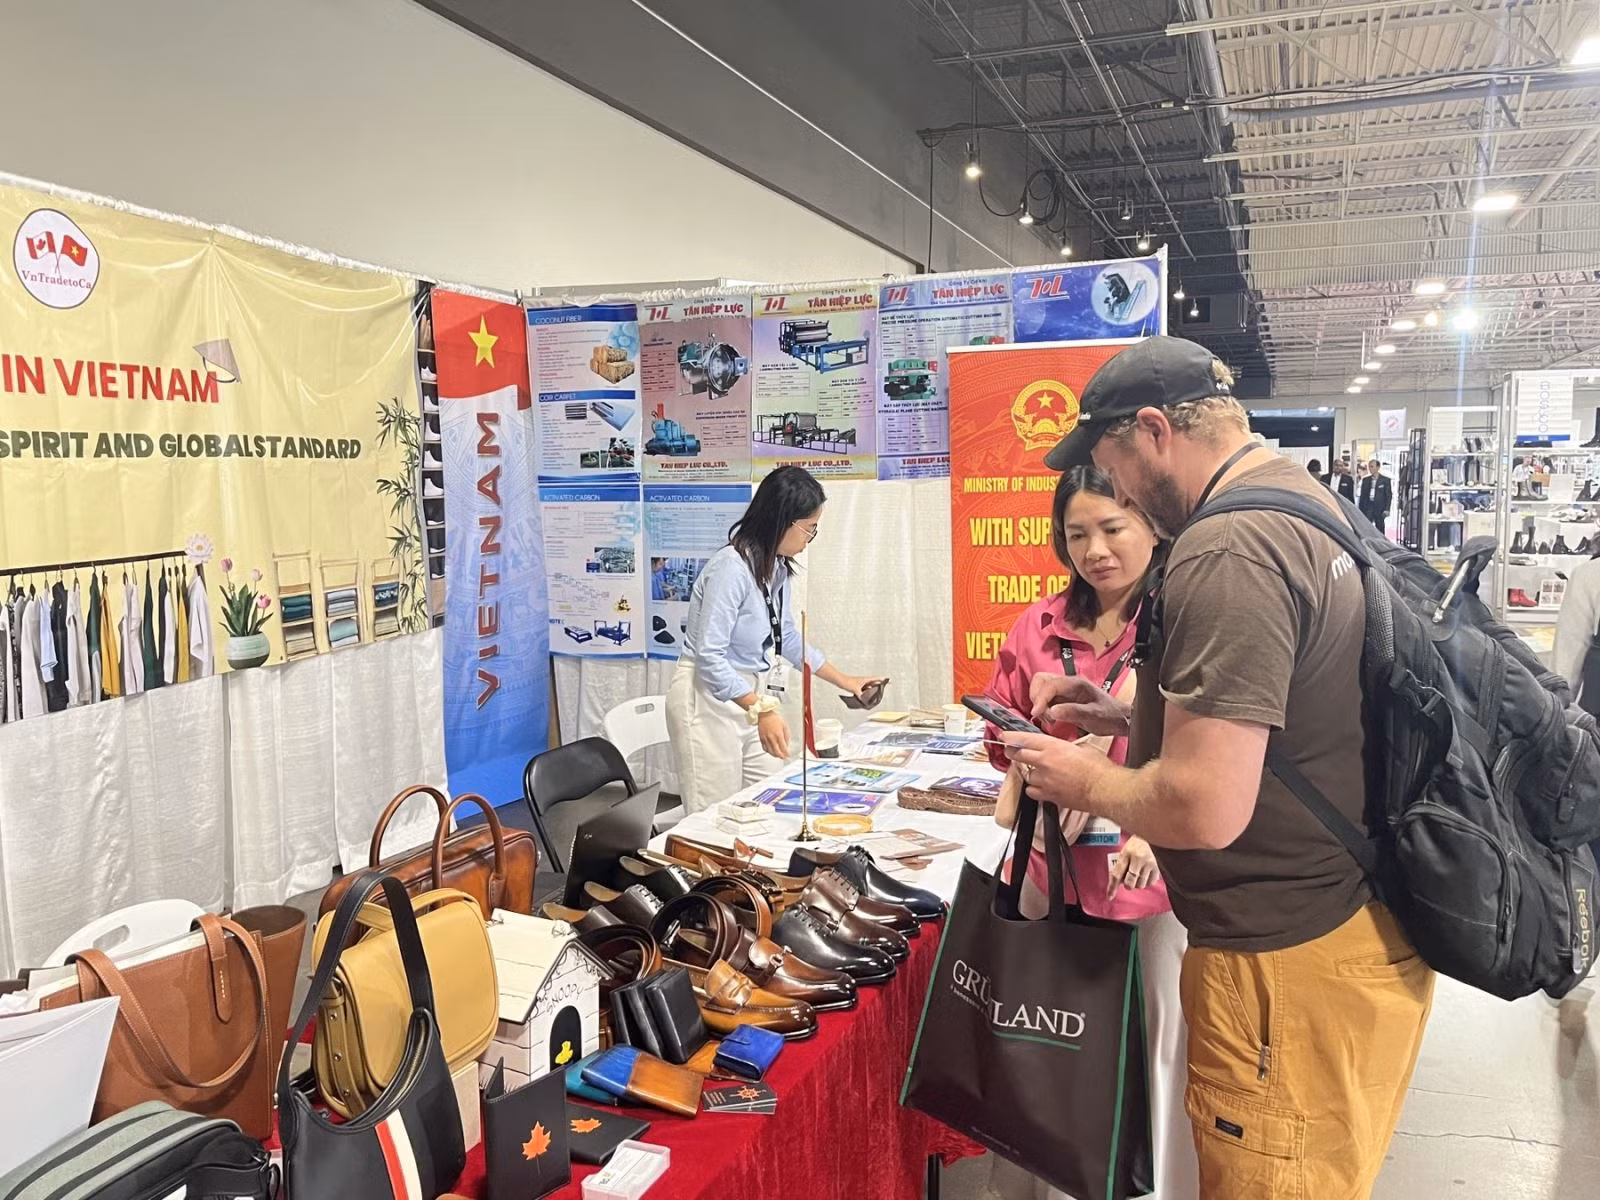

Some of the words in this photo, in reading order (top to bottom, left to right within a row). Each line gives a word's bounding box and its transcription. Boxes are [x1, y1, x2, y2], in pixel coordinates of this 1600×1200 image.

[21, 269, 92, 289] VnTradetoCa
[932, 288, 954, 299] TÂN
[956, 285, 982, 299] HIỆP
[984, 283, 1005, 296] LỰC
[683, 305, 700, 316] TÂN
[701, 302, 722, 315] HIỆP
[724, 303, 744, 314] LỰC
[808, 297, 828, 308] TÂN
[829, 294, 852, 307] HIỆP
[854, 293, 873, 305] LỰC
[535, 316, 565, 325] COCONUT
[2, 353, 46, 395] IN
[53, 357, 220, 404] VIETNAM
[0, 430, 88, 459] SPIRIT
[93, 432, 154, 459] AND
[684, 494, 710, 502] CARBON
[964, 477, 1008, 493] MINISTRY
[1012, 476, 1024, 492] OF
[970, 517, 1013, 546] WITH
[476, 412, 502, 710] VIETNAM
[988, 575, 1041, 604] TRADE
[1575, 888, 1590, 968] Reebok
[547, 983, 584, 1015] SNOOPY
